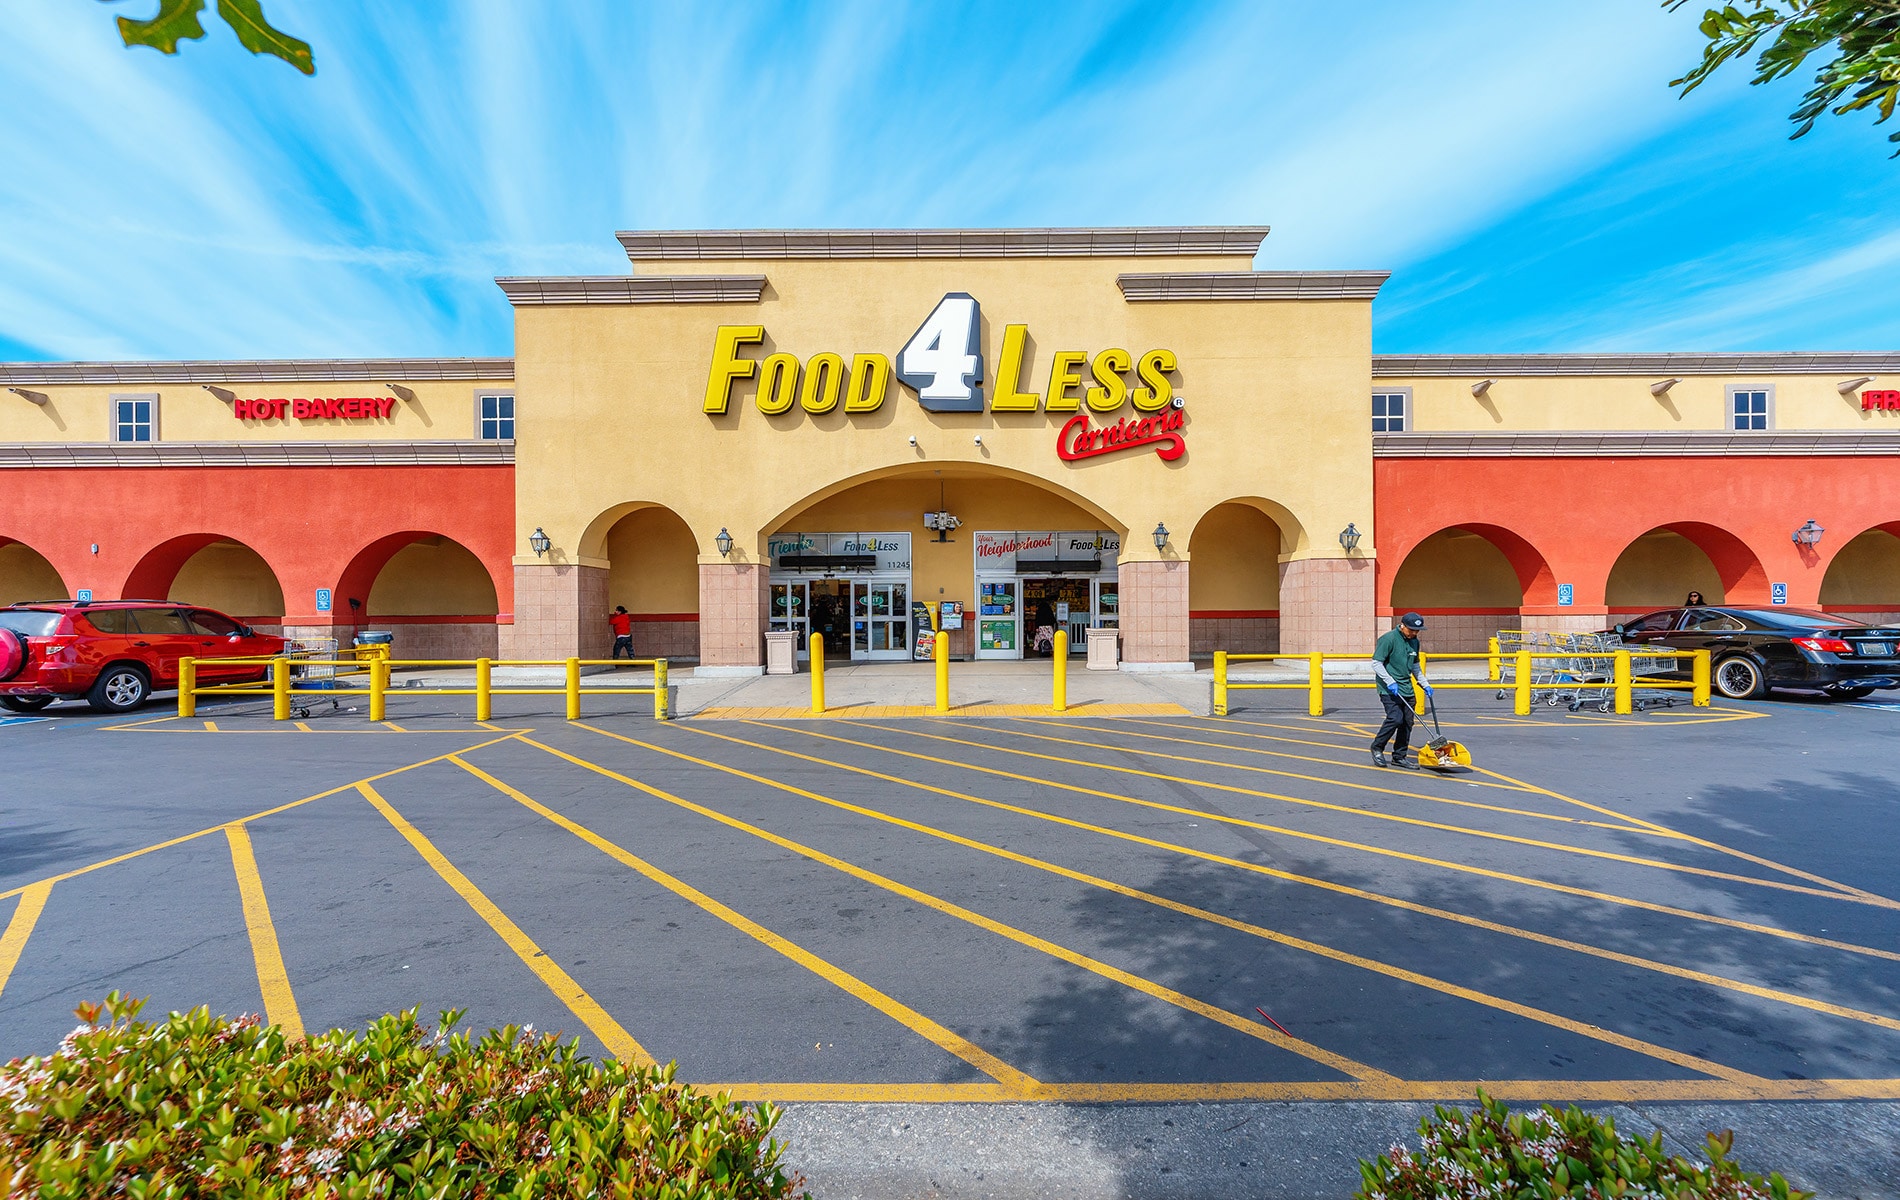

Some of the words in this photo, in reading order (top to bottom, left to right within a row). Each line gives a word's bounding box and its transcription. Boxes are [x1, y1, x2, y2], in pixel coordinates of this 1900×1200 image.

[898, 293, 983, 412] 4
[235, 398, 289, 420] HOT
[293, 397, 395, 419] BAKERY
[867, 537, 877, 552] 4
[977, 533, 1052, 557] Neighborhood
[1093, 536, 1103, 550] 4
